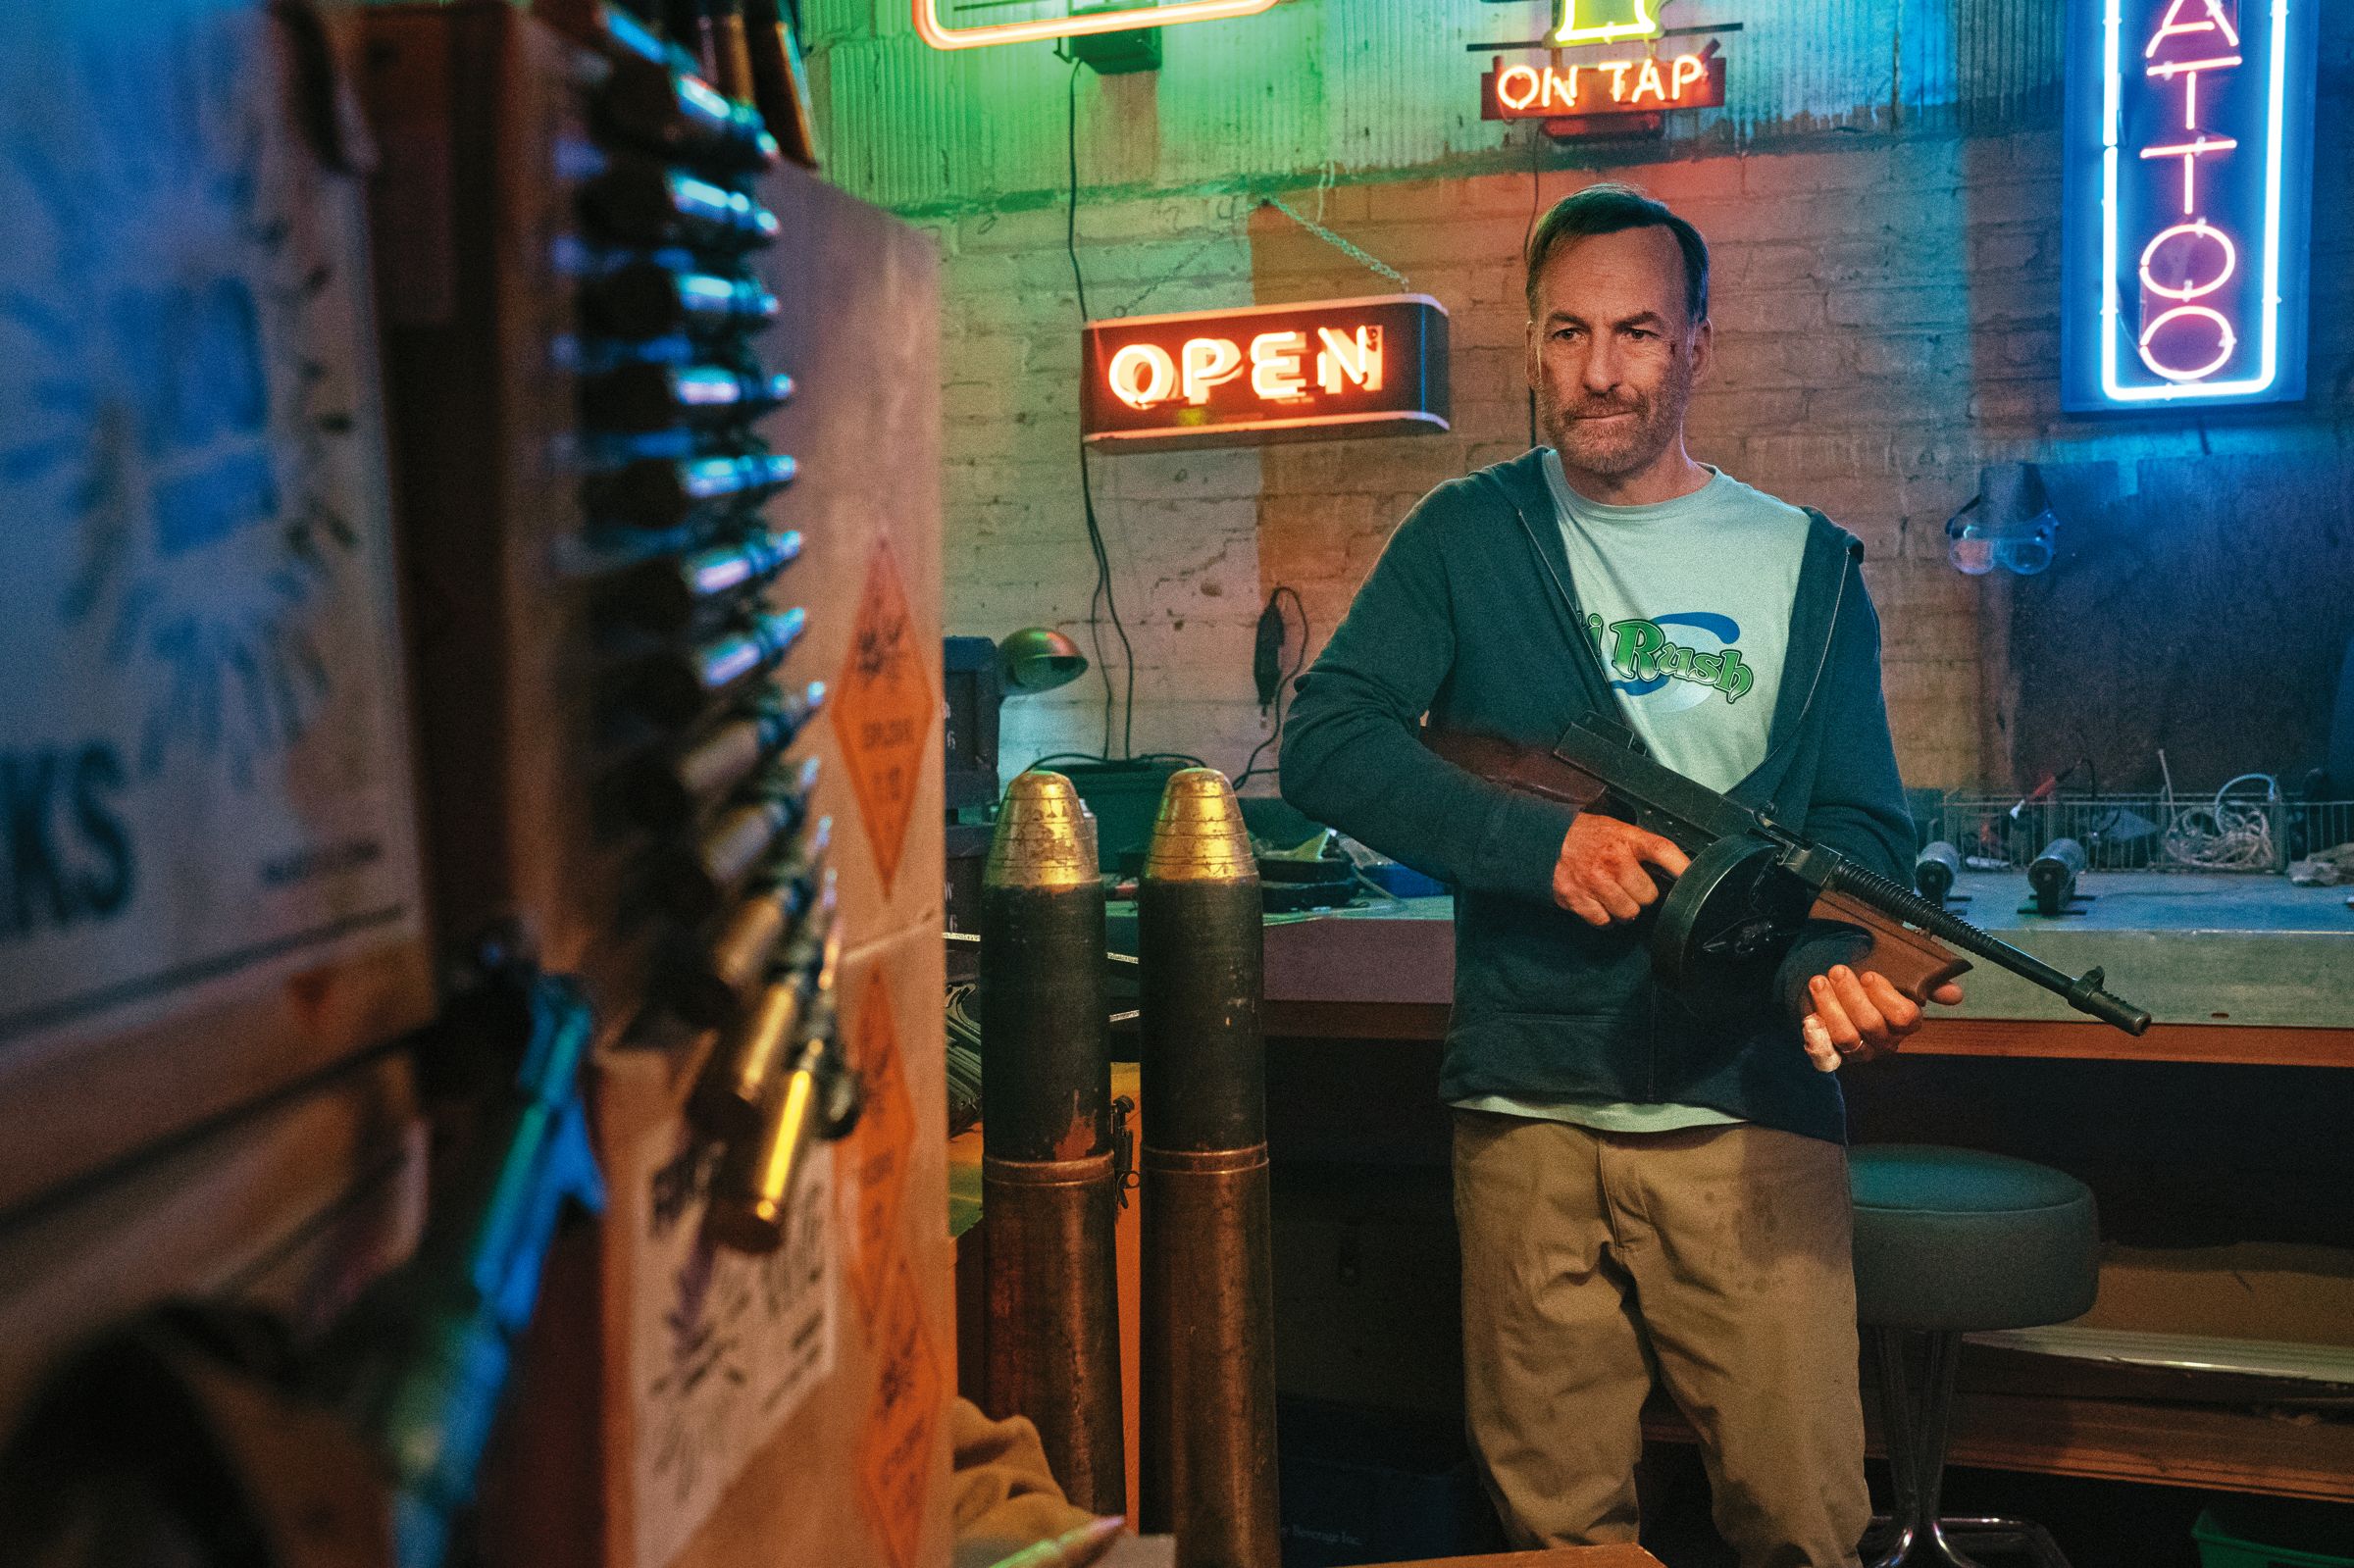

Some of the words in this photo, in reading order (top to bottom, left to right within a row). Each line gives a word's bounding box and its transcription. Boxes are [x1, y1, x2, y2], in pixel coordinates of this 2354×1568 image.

[1497, 65, 1578, 110] ON
[1598, 55, 1703, 103] TAP
[1108, 324, 1384, 410] OPEN
[1609, 619, 1755, 704] Rush
[0, 742, 133, 935] KS
